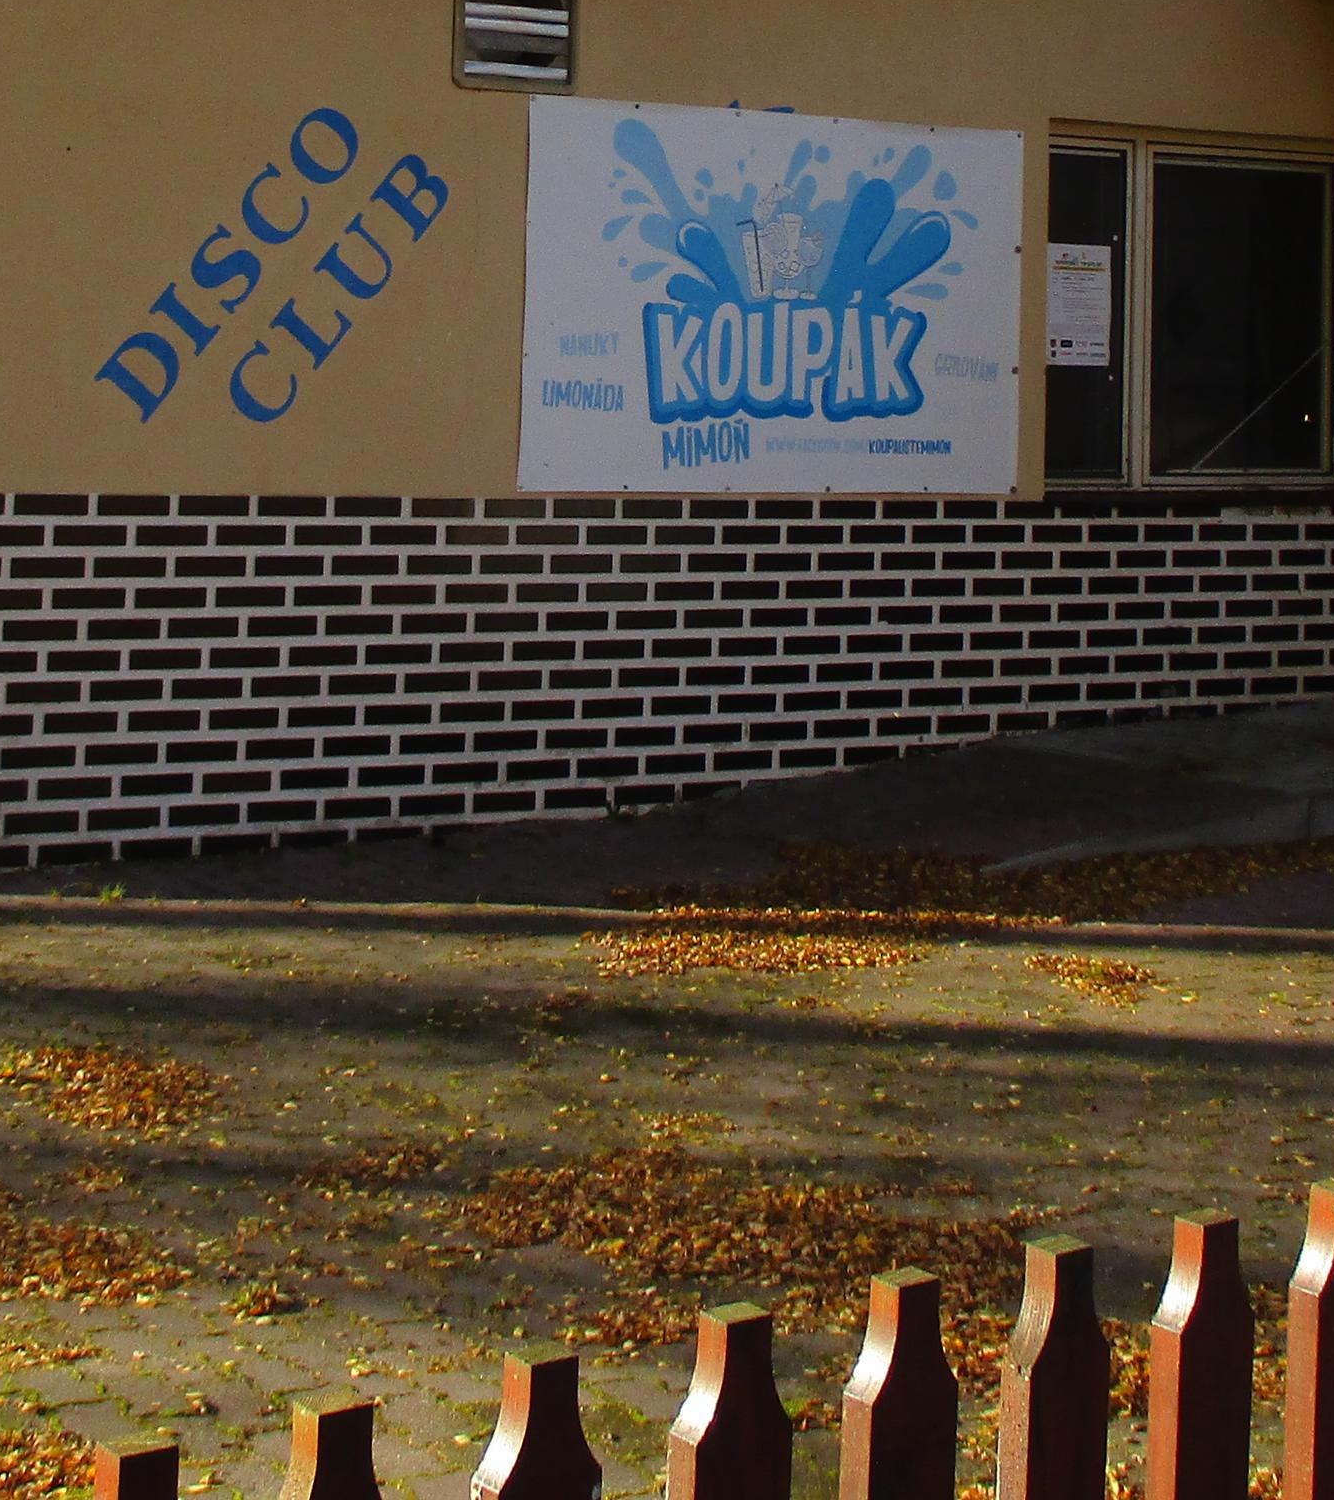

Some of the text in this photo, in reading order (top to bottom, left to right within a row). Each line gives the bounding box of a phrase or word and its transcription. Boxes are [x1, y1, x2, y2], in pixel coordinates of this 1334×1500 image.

[94, 108, 359, 424] DISCO
[230, 153, 449, 424] CLUB
[655, 290, 915, 406] KOUPÁK
